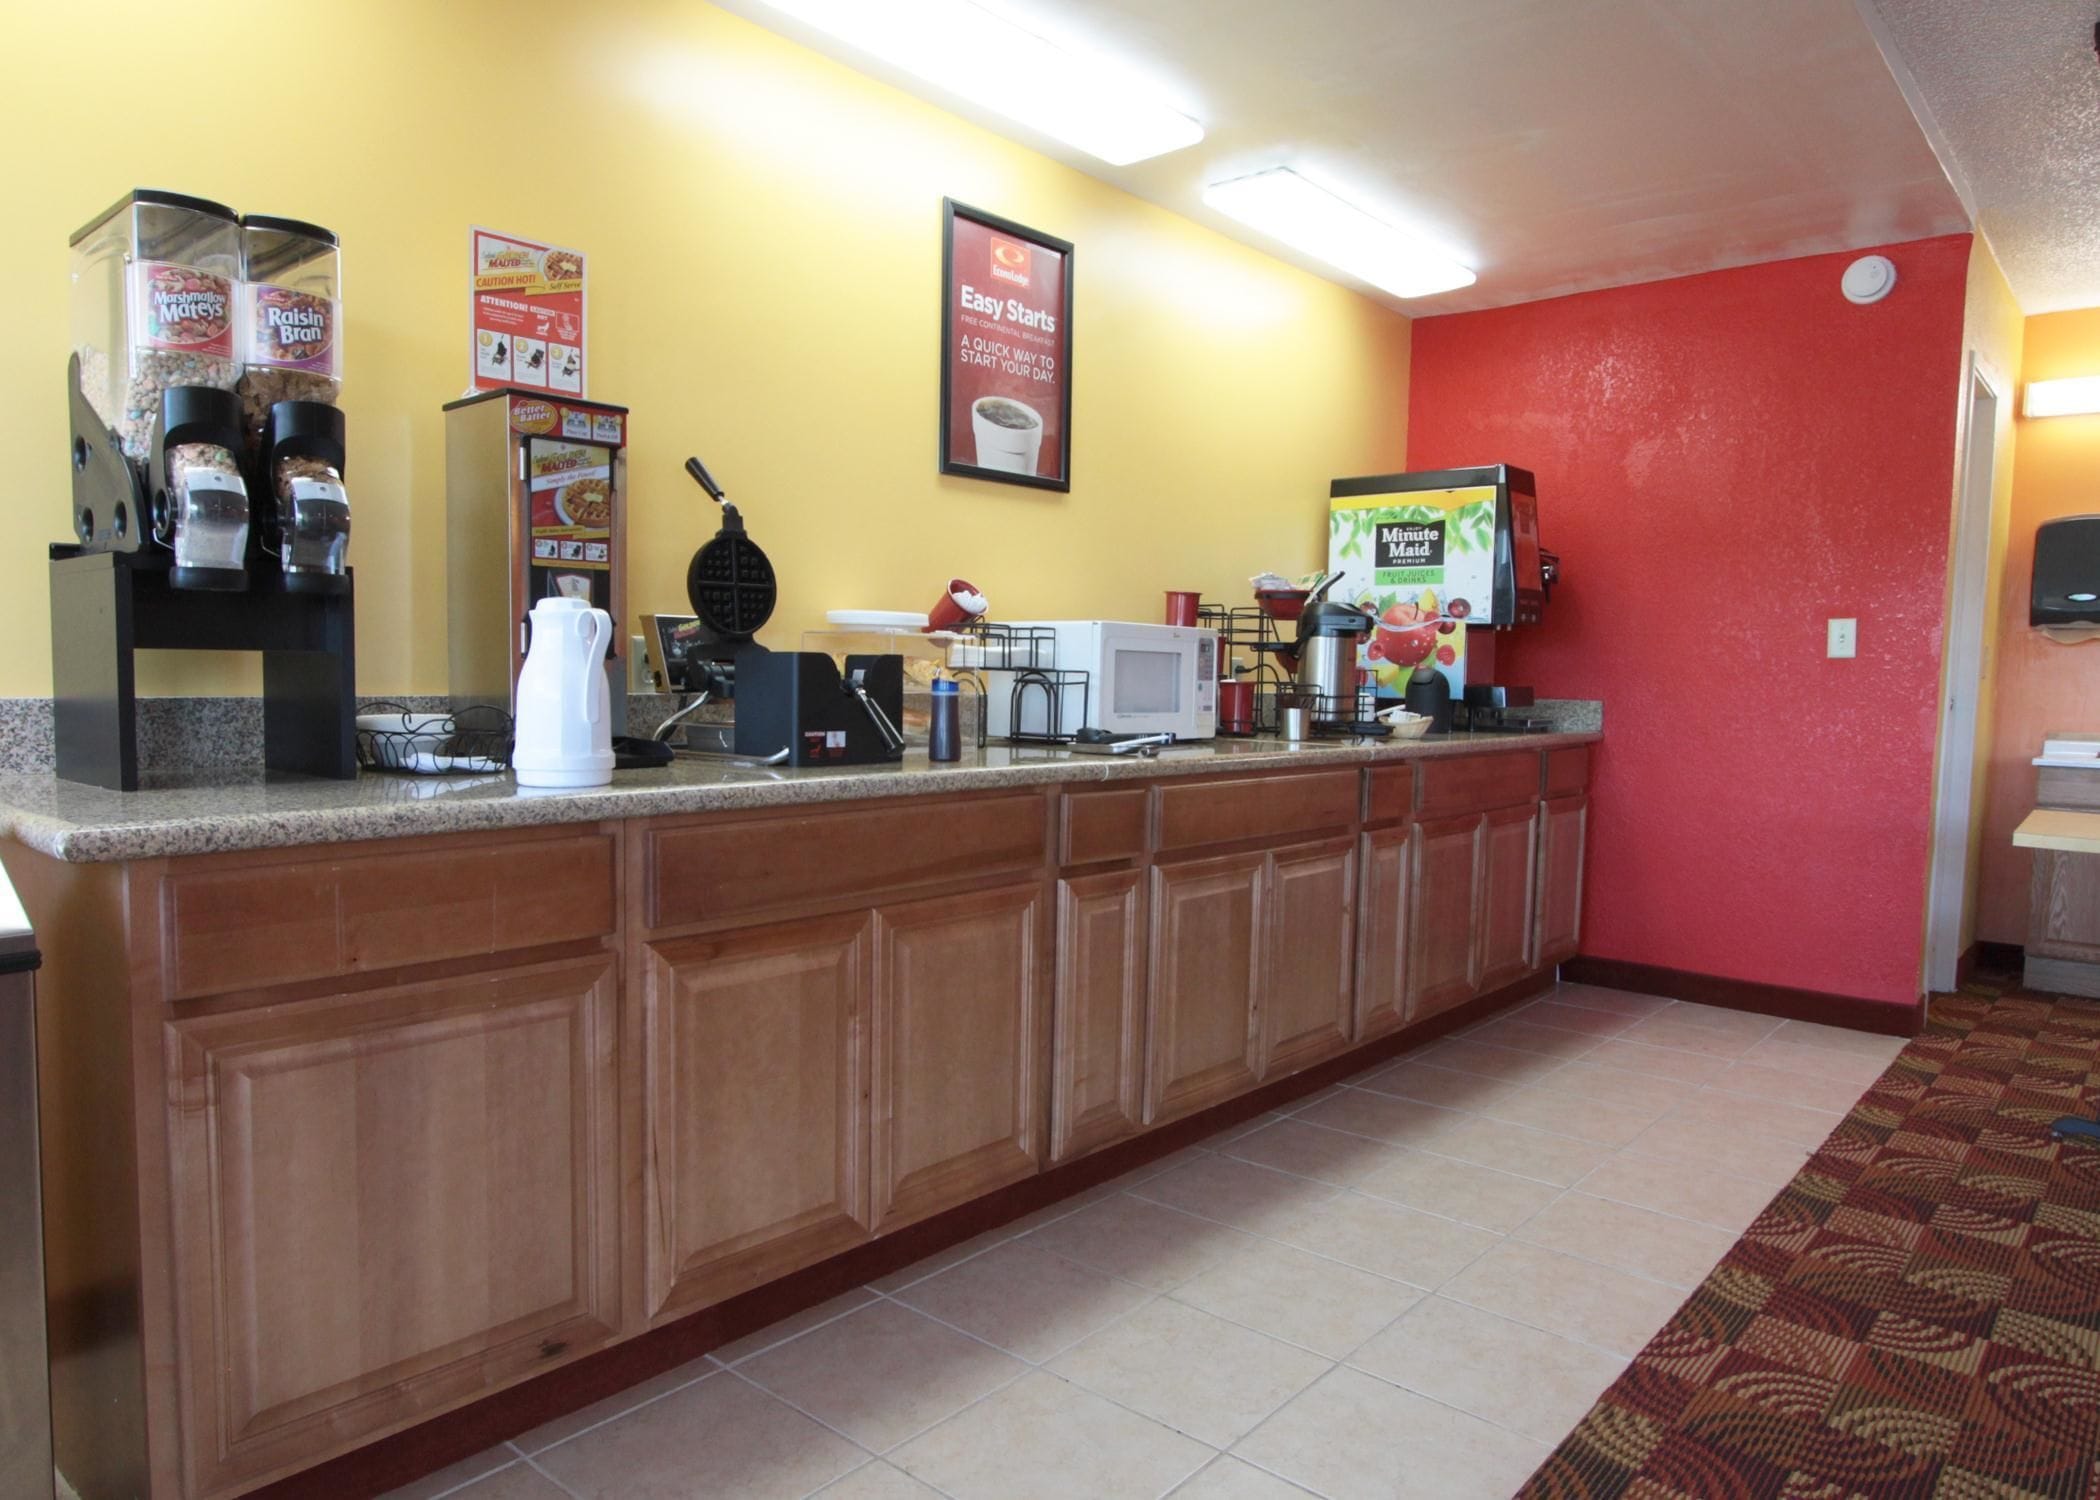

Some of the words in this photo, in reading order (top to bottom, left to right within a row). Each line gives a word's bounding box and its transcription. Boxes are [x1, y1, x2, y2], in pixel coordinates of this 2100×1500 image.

[476, 276, 514, 288] CAUTION
[516, 273, 536, 285] HOT!
[154, 291, 226, 305] Marshmallow
[480, 295, 529, 312] ATTENTION!
[159, 301, 224, 323] Mateys
[961, 284, 1004, 321] Easy
[1006, 299, 1056, 332] Starts
[268, 307, 325, 328] Raisin
[280, 325, 322, 345] Bran
[961, 314, 978, 326] FREE
[979, 319, 1021, 338] CONTINENTAL
[1022, 331, 1055, 347] BREAKFAST
[961, 334, 970, 348] A
[973, 337, 1010, 358] QUICK
[1013, 347, 1038, 365] WAY
[1040, 355, 1055, 370] TO
[961, 349, 997, 369] START
[1000, 359, 1030, 378] YOUR
[1032, 366, 1056, 384] DAY.
[514, 405, 545, 416] Better
[519, 412, 551, 423] Batter
[1382, 527, 1439, 543] Minute
[1388, 541, 1431, 558] Maid
[1390, 576, 1396, 584] &
[1398, 575, 1426, 584] DRINKS
[1407, 569, 1435, 577] JUICES
